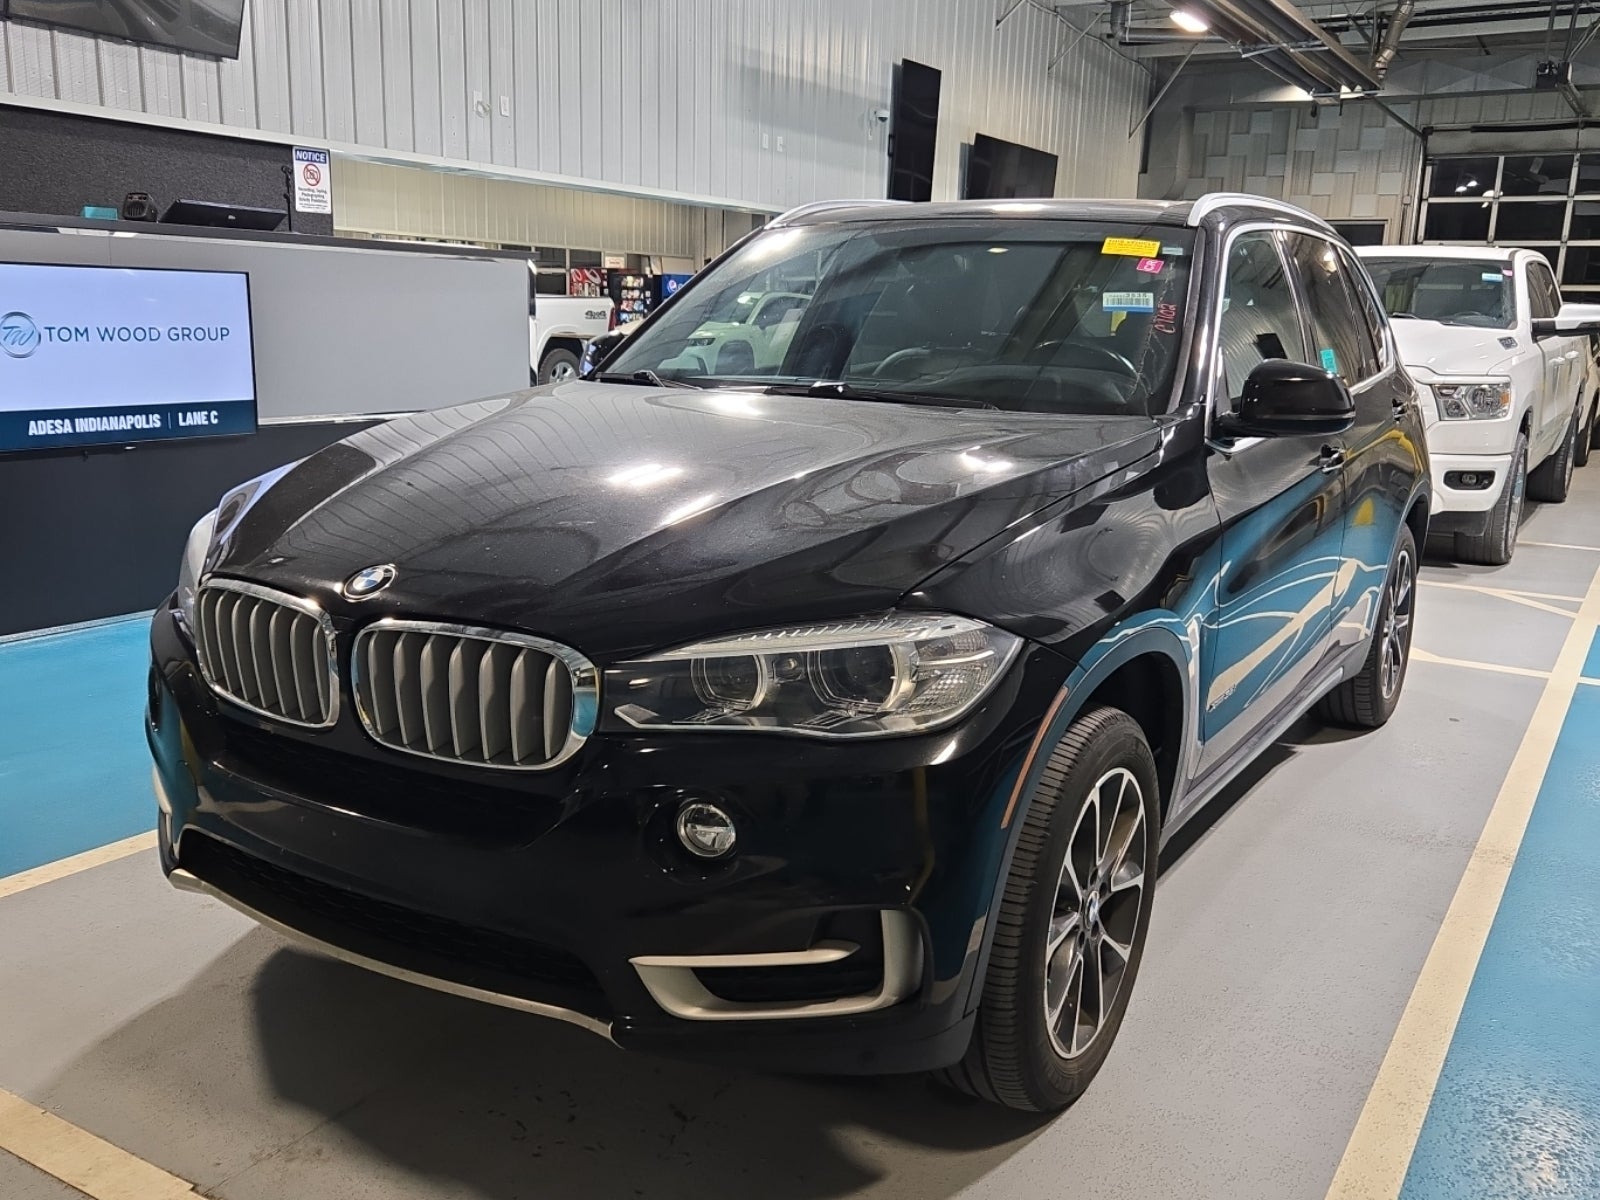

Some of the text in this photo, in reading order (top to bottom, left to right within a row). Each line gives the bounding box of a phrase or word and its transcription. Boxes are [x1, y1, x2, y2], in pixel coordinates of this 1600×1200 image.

[296, 150, 326, 162] NOTICE
[44, 326, 230, 342] TOM WOOD GROUP
[28, 410, 219, 436] ADESA INDIANAPOLIS LANE C
